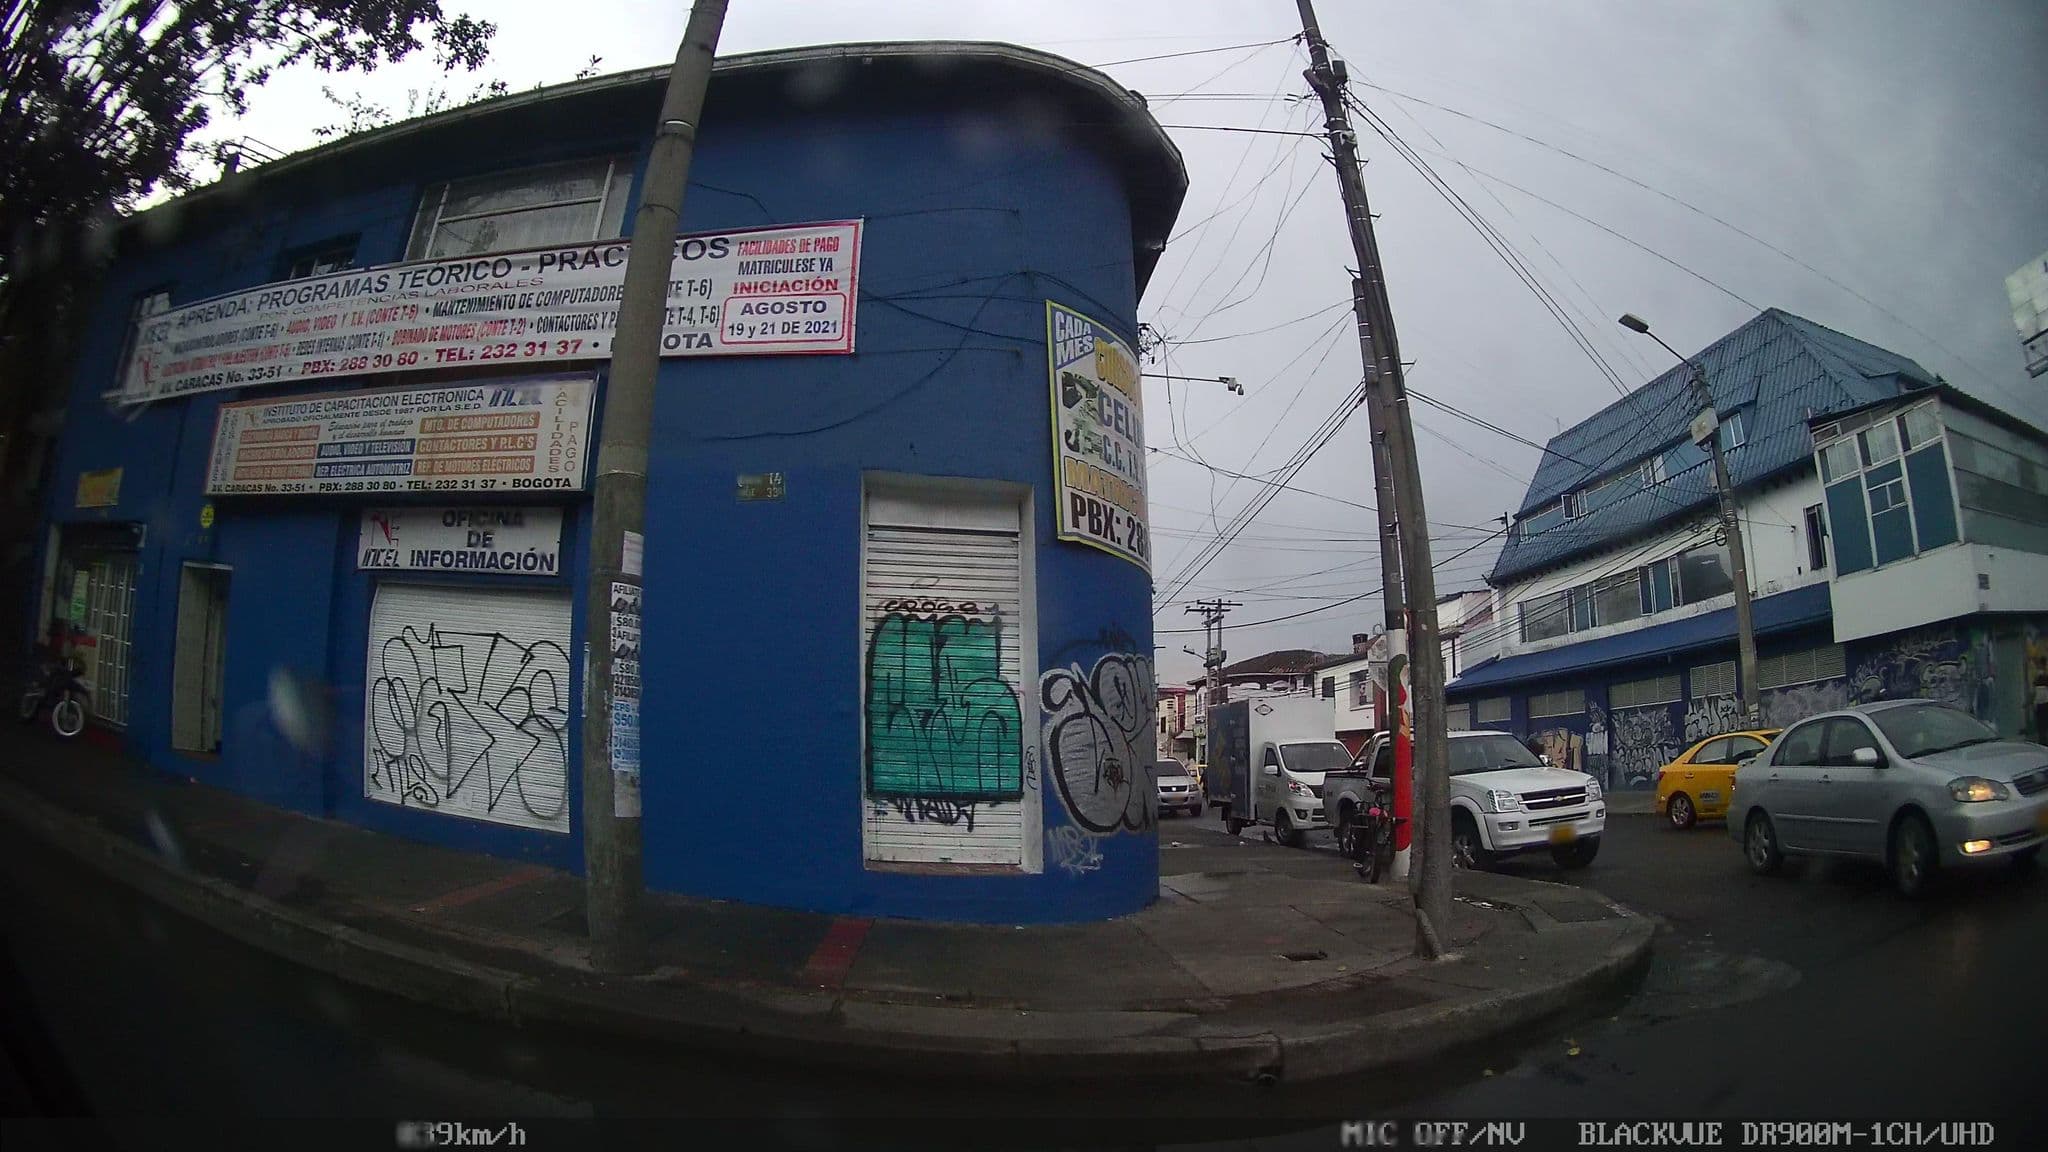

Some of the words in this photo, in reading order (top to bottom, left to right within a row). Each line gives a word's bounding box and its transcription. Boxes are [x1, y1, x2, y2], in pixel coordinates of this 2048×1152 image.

[737, 238, 796, 257] FACILIDADES
[800, 238, 811, 254] DE
[814, 236, 840, 253] PAGO
[738, 258, 815, 276] MATRICULESE
[819, 257, 834, 273] YA
[257, 275, 390, 311] PROGRAMAS
[398, 257, 513, 289] TEÓRICO
[424, 277, 544, 298] LABORALES
[733, 276, 838, 294] INICIACIÓN
[433, 293, 519, 317] MANTENIMIENTO
[518, 292, 534, 309] DE
[687, 278, 713, 300] T-6)
[740, 300, 827, 316] AGOSTO
[537, 312, 599, 334] CONTACTORES
[600, 311, 608, 330] Y
[700, 305, 720, 328] T-6)
[728, 323, 745, 336] 19
[749, 326, 757, 338] y
[760, 321, 776, 335] 21
[781, 321, 801, 335] DE
[804, 320, 838, 335] 2021
[1055, 311, 1092, 342] CADA
[1055, 335, 1095, 366] MES
[175, 372, 223, 392] CARACAS
[226, 370, 244, 384] No.
[248, 365, 282, 381] 33-51
[301, 359, 335, 375] PBX:
[339, 356, 368, 371] 288
[373, 353, 392, 369] 30
[435, 347, 475, 362] TEL:
[480, 343, 518, 360] 232
[523, 341, 547, 357] 31
[556, 339, 583, 355] 37
[263, 403, 307, 417] INSTITUTO
[309, 402, 321, 414] DE
[324, 396, 398, 413] CAPACITACION
[401, 389, 484, 406] ELECTRONICA
[416, 405, 438, 414] POR
[439, 404, 451, 412] LA
[447, 418, 460, 429] DE
[461, 414, 535, 429] COMPUTADORES
[419, 437, 488, 452] CONTACTORES
[490, 437, 497, 448] Y
[482, 457, 531, 471] ELECTRICOS
[225, 484, 262, 493] CARACAS
[265, 483, 279, 492] No.
[281, 483, 305, 492] 33-51
[319, 482, 342, 491] PBX:
[344, 481, 365, 491] 288
[367, 481, 381, 490] 30
[407, 480, 432, 490] TEL:
[435, 479, 458, 490] 232
[462, 479, 475, 489] 31
[481, 479, 496, 489] 37
[512, 478, 572, 489] BOGOTA
[442, 509, 525, 528] OFICINA
[1070, 492, 1121, 546] PBX:
[466, 531, 496, 548] DE
[410, 547, 555, 571] INFORMACIÓN
